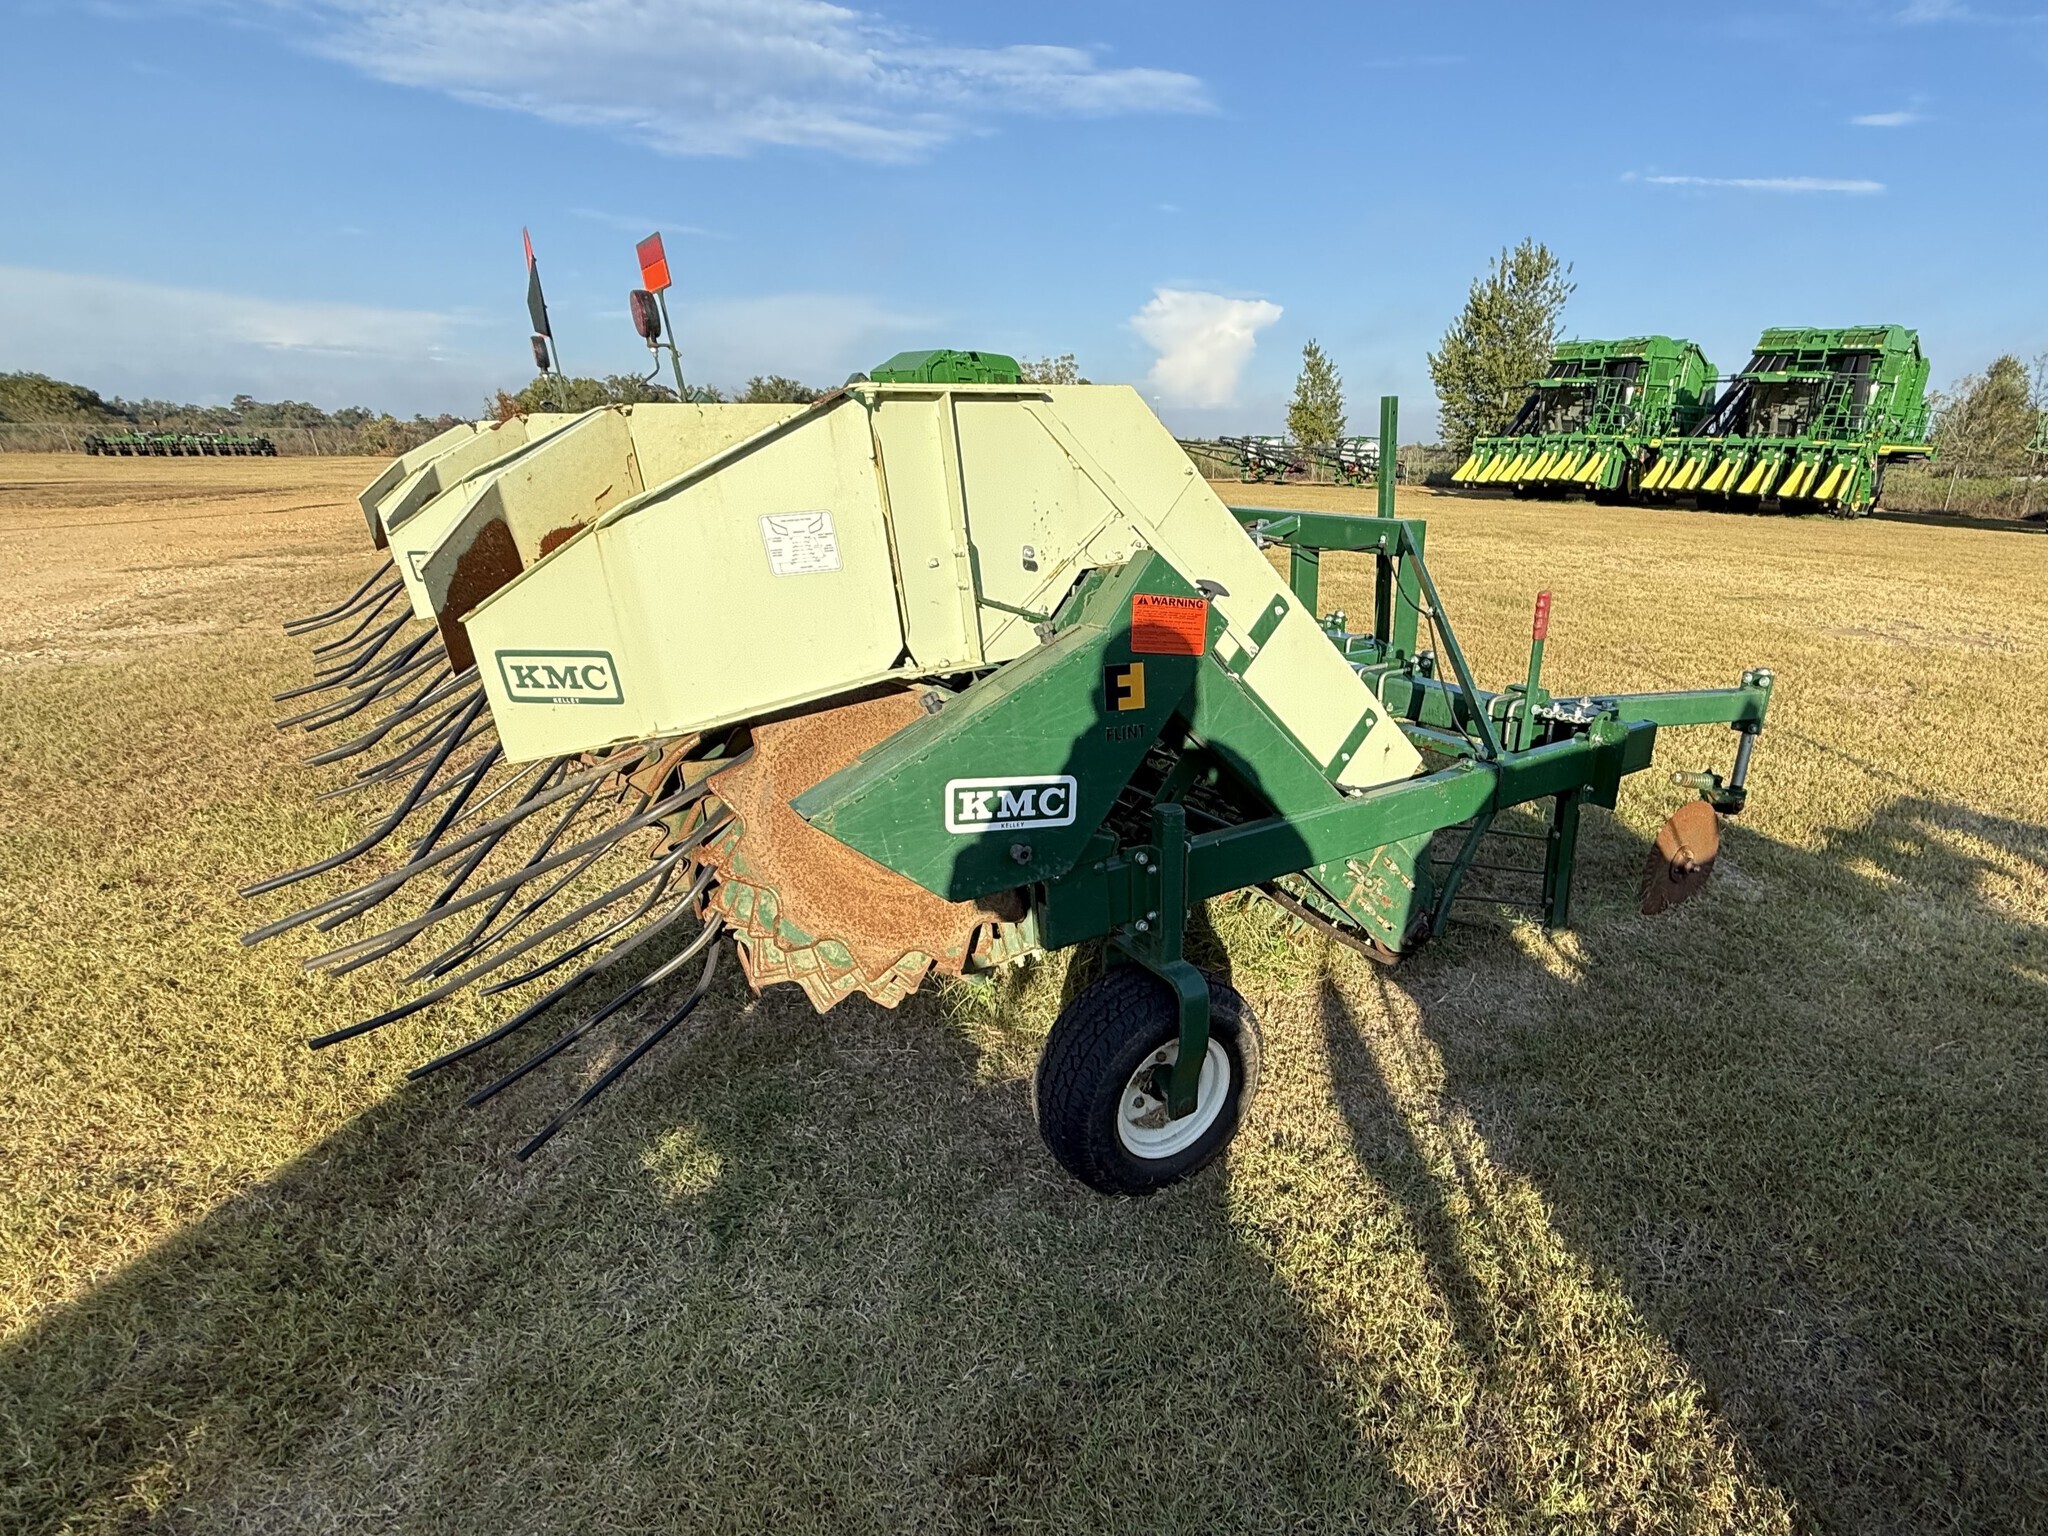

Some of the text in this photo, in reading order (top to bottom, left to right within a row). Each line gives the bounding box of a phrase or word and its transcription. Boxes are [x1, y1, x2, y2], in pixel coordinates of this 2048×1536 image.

[1151, 596, 1204, 609] WARNING
[510, 665, 608, 690] KMC
[1105, 723, 1145, 742] FLINT
[958, 787, 1065, 820] KMC
[1001, 821, 1025, 829] KELLEY
